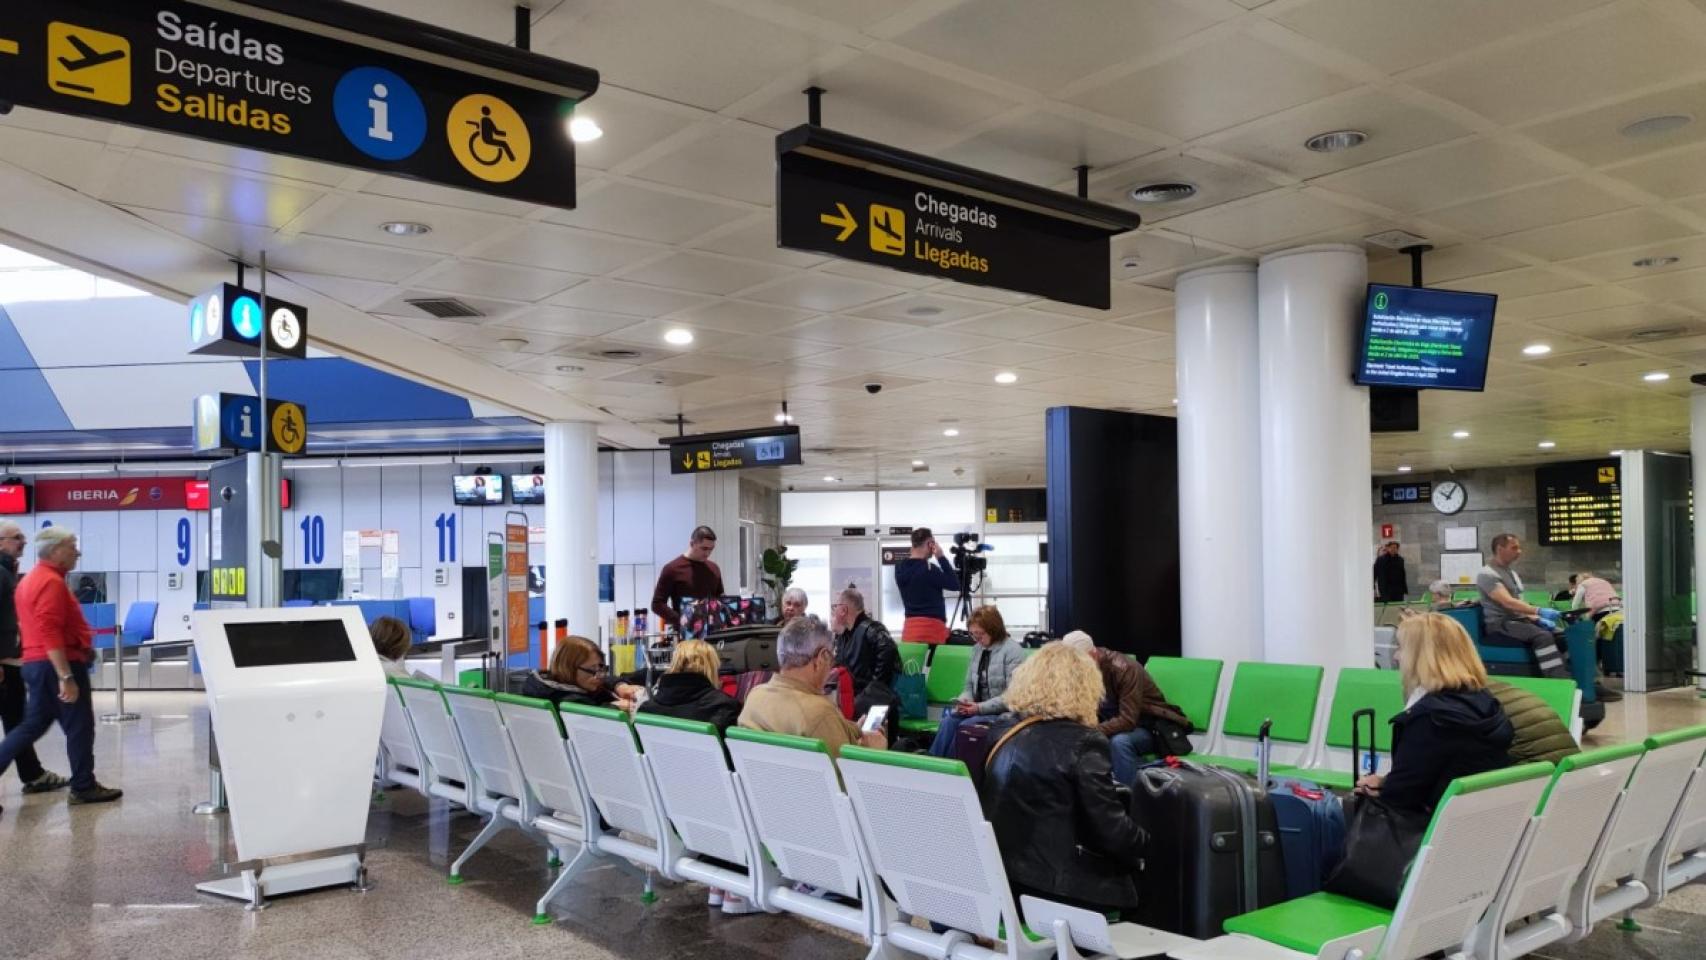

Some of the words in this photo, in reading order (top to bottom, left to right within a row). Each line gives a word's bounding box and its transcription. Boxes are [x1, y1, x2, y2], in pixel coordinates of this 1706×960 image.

[155, 10, 285, 66] Saídas
[154, 48, 312, 105] Departures
[156, 83, 292, 136] Salidas
[914, 191, 998, 230] Chegadas
[915, 217, 963, 243] Arrivals
[914, 239, 989, 274] Llegadas
[67, 489, 119, 501] IBERIA
[177, 517, 191, 567] 9
[300, 515, 325, 565] 10
[435, 512, 456, 563] 11
